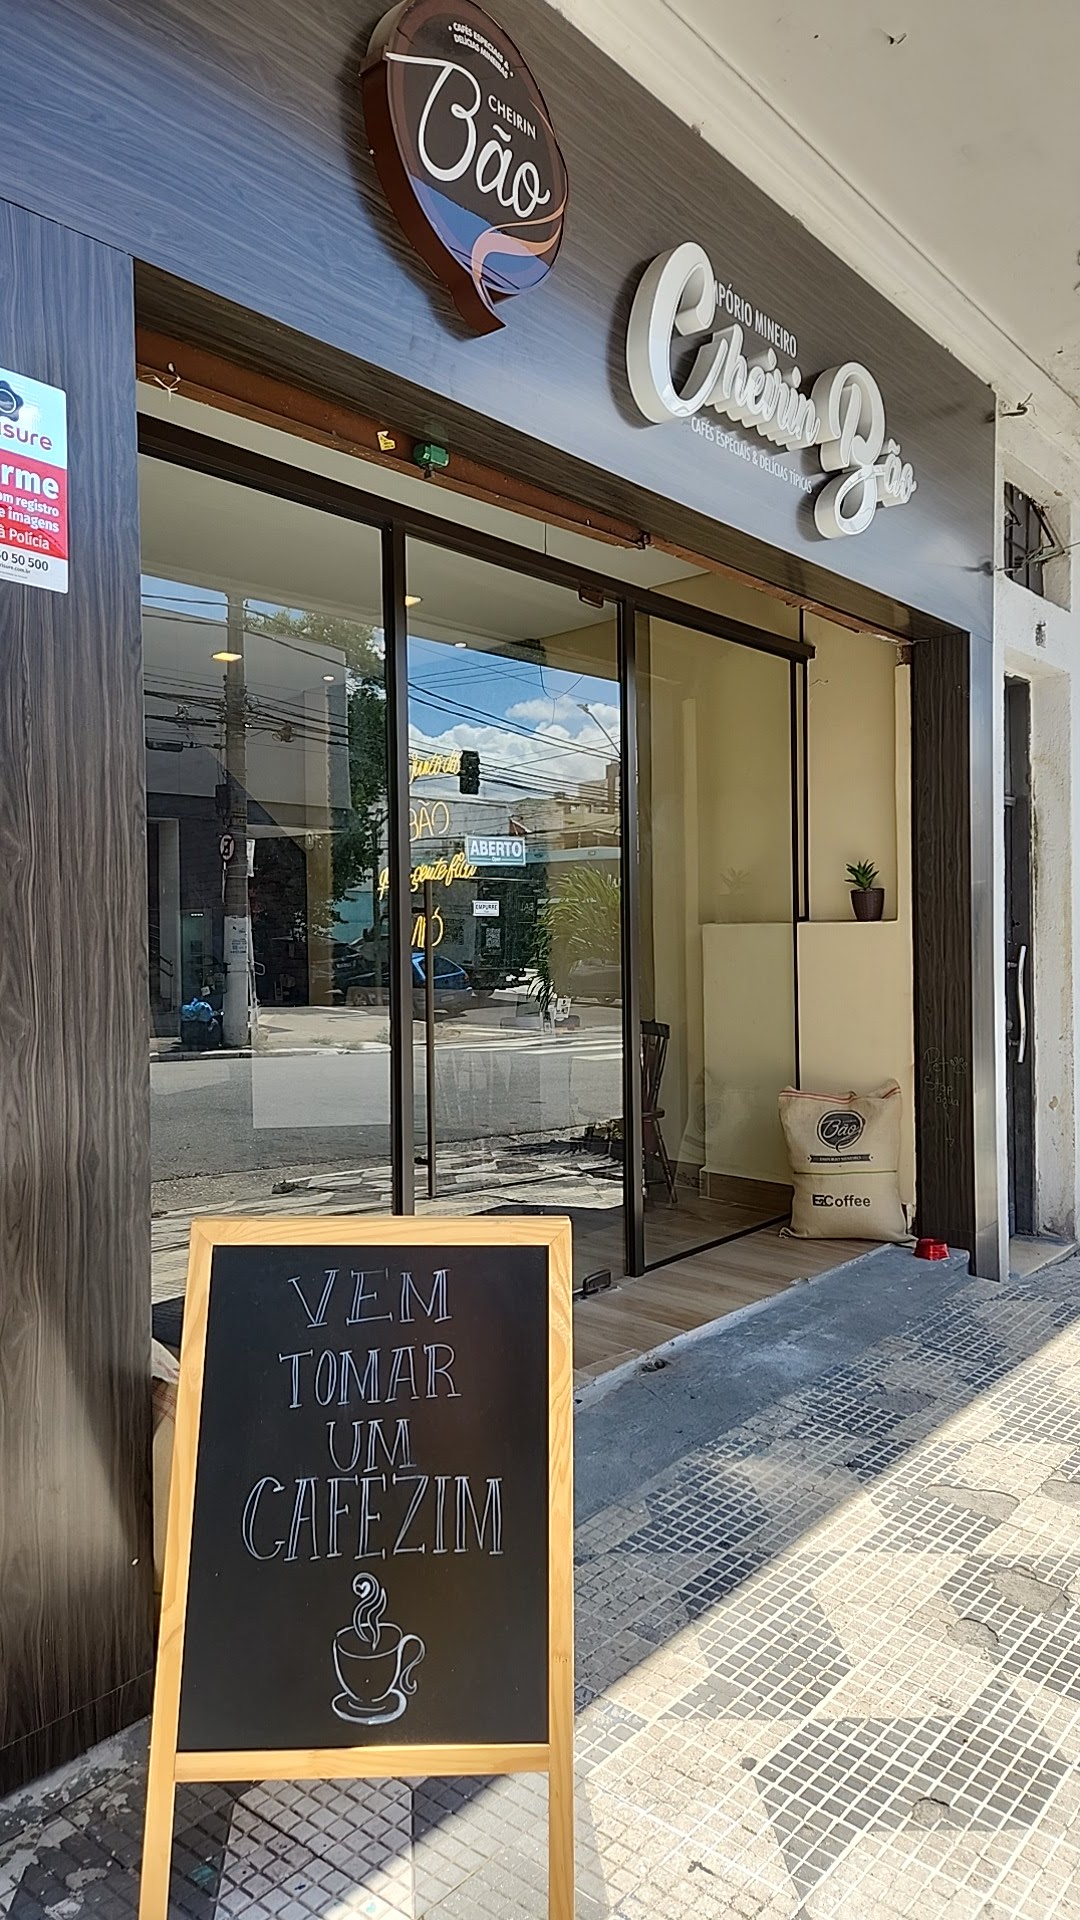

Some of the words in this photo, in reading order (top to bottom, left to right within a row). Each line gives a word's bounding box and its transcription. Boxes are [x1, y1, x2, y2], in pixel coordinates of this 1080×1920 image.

[386, 52, 550, 218] Bão
[487, 95, 536, 140] CHEIRIN
[714, 279, 753, 327] PÓRIO
[754, 309, 797, 358] MINEIRO
[632, 241, 821, 448] Cheirin
[816, 361, 917, 538] Bão
[0, 422, 52, 450] sure
[691, 416, 715, 442] CAFÉS
[715, 429, 751, 462] ESPECIAIS
[752, 450, 758, 466] &
[759, 454, 788, 482] DELÍCIAS
[789, 468, 812, 494] TÍPICAS
[8, 506, 60, 533] imagens
[15, 496, 59, 517] registro
[0, 550, 9, 562] 0
[11, 553, 26, 566] 50
[28, 557, 49, 571] 500
[9, 527, 50, 550] Polícia
[470, 839, 523, 858] ABERTO
[822, 1119, 860, 1139] Bão
[287, 1268, 452, 1329] VEM
[278, 1343, 462, 1409] TOMAR
[326, 1418, 417, 1473] UM
[242, 1473, 504, 1562] CAFEZIM
